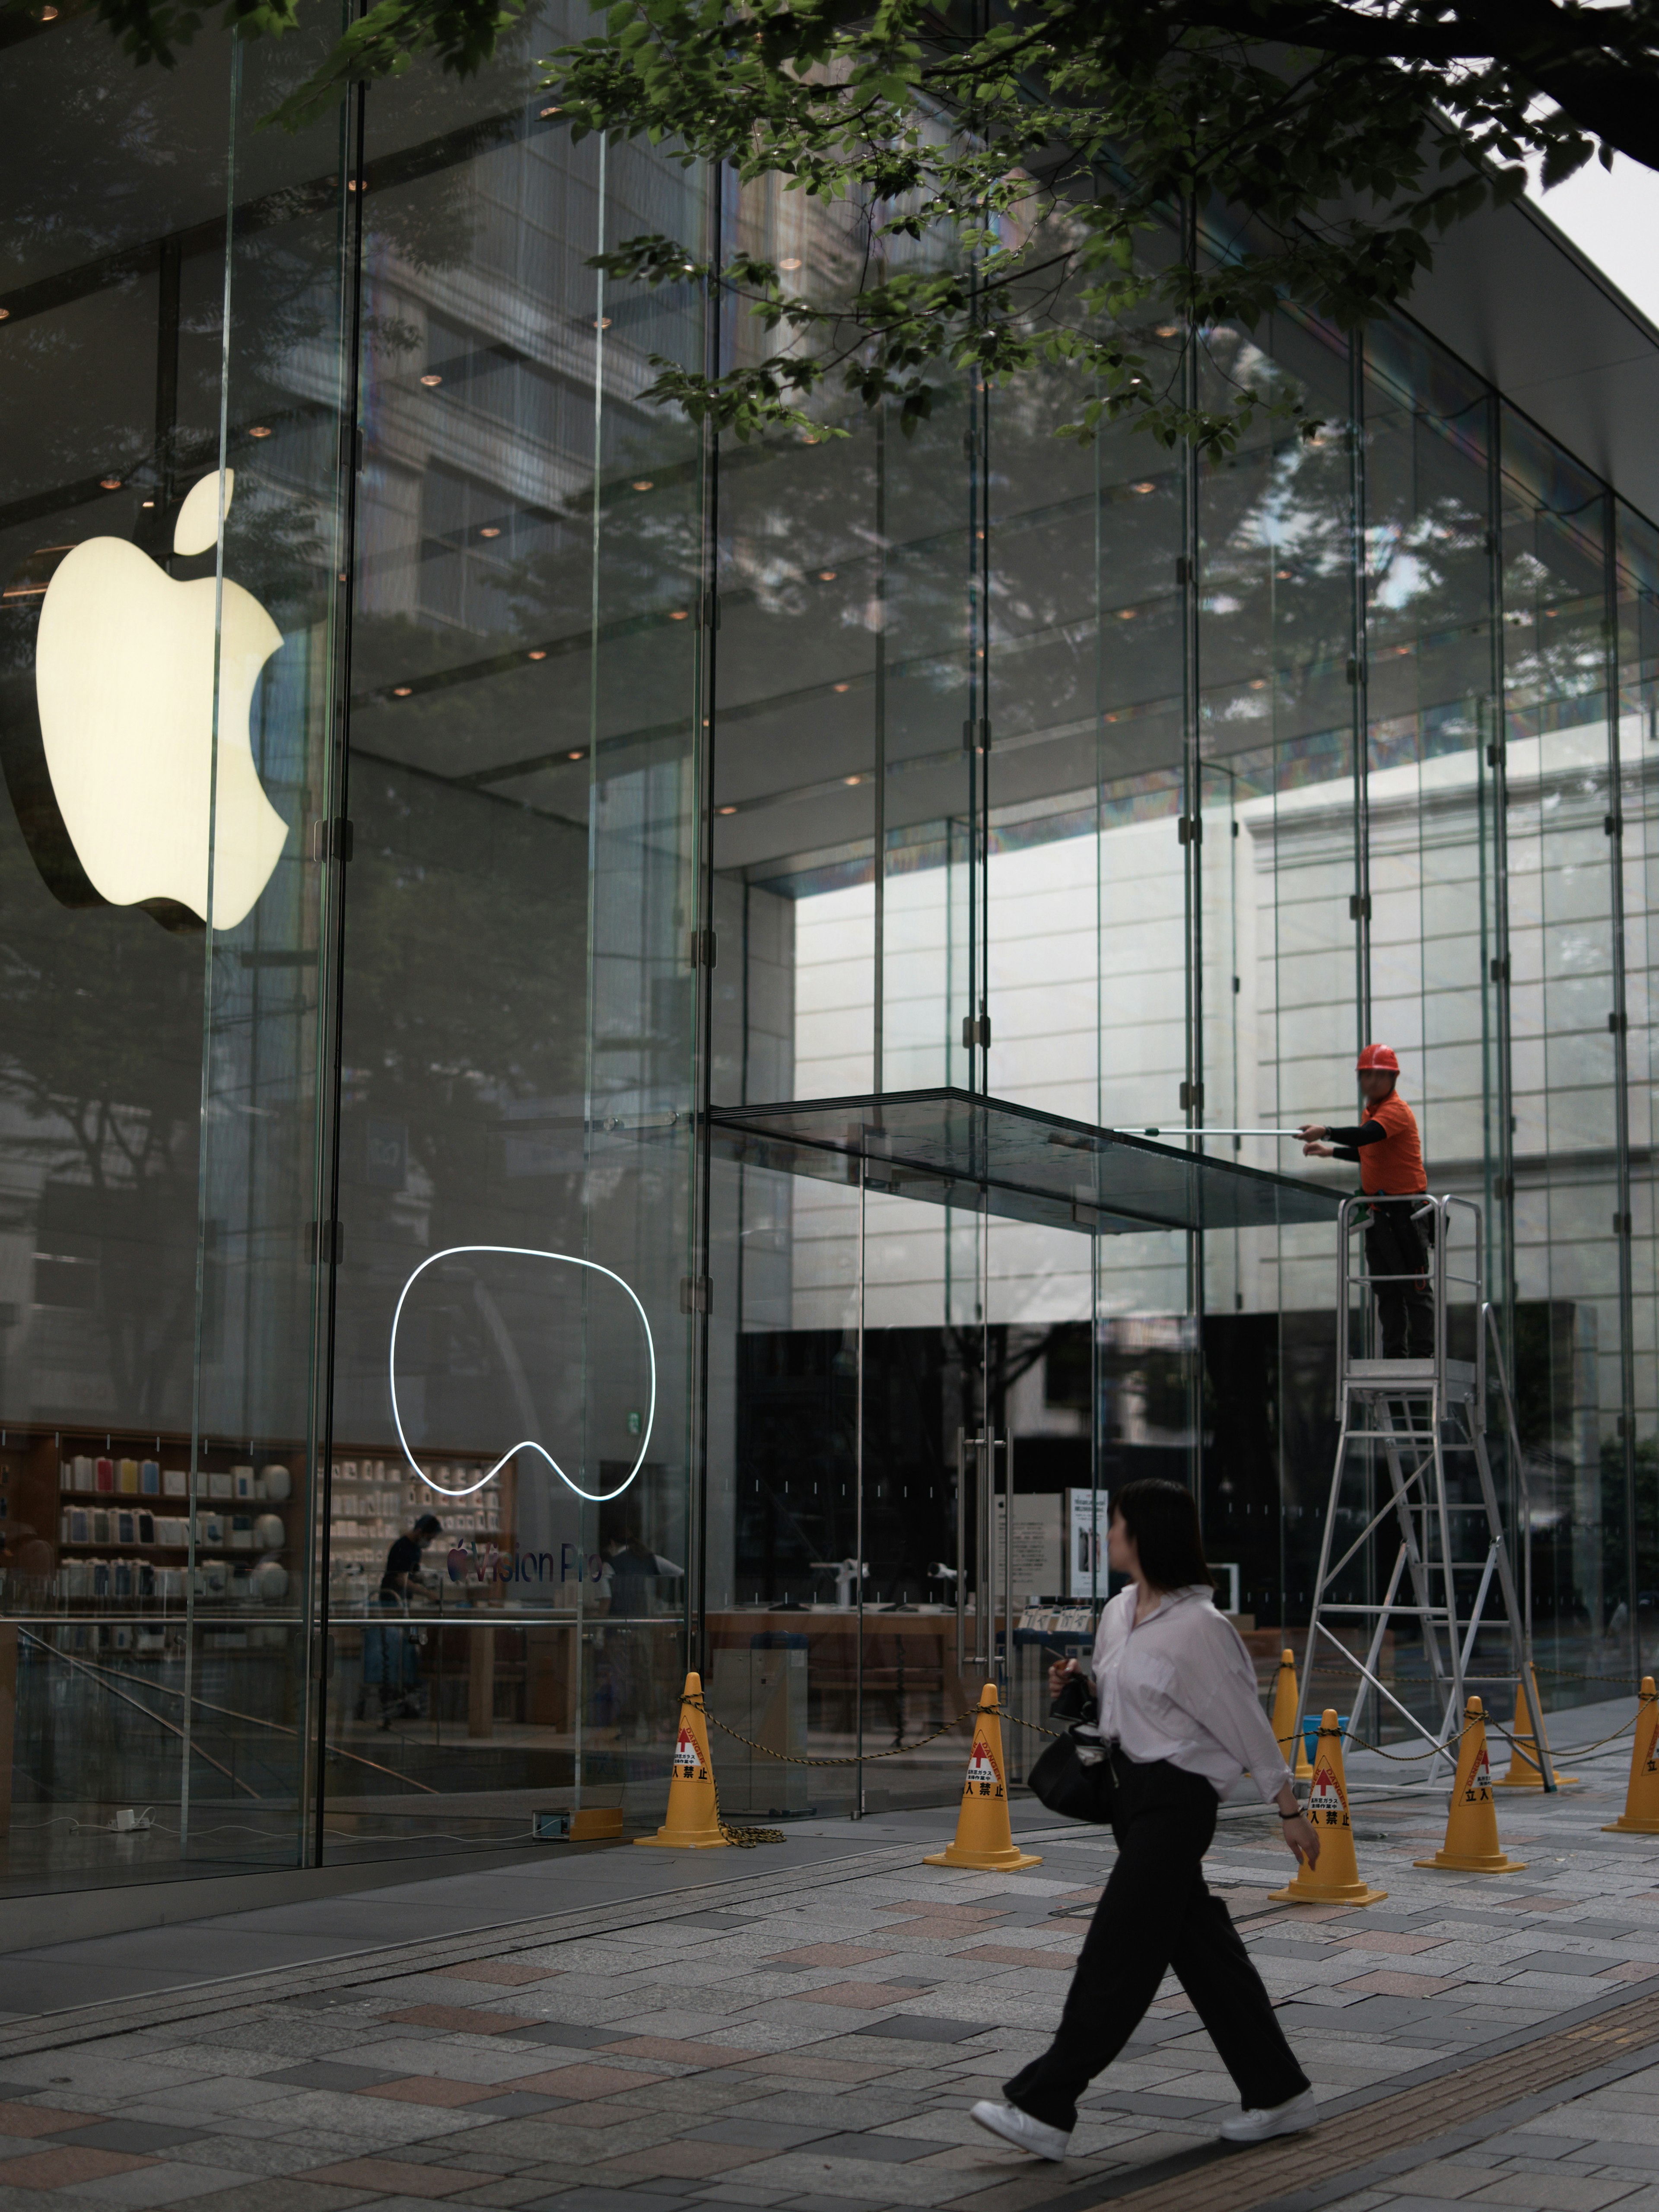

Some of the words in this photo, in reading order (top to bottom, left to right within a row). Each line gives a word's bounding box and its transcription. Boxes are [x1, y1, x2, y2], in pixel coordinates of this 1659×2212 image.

[471, 1541, 553, 1582] Vision
[562, 1543, 602, 1583] Pro
[686, 1728, 705, 1764] DANGER
[982, 1742, 1001, 1781] DANGER
[1467, 1750, 1484, 1786] DANGER
[1326, 1768, 1347, 1808] DANGER
